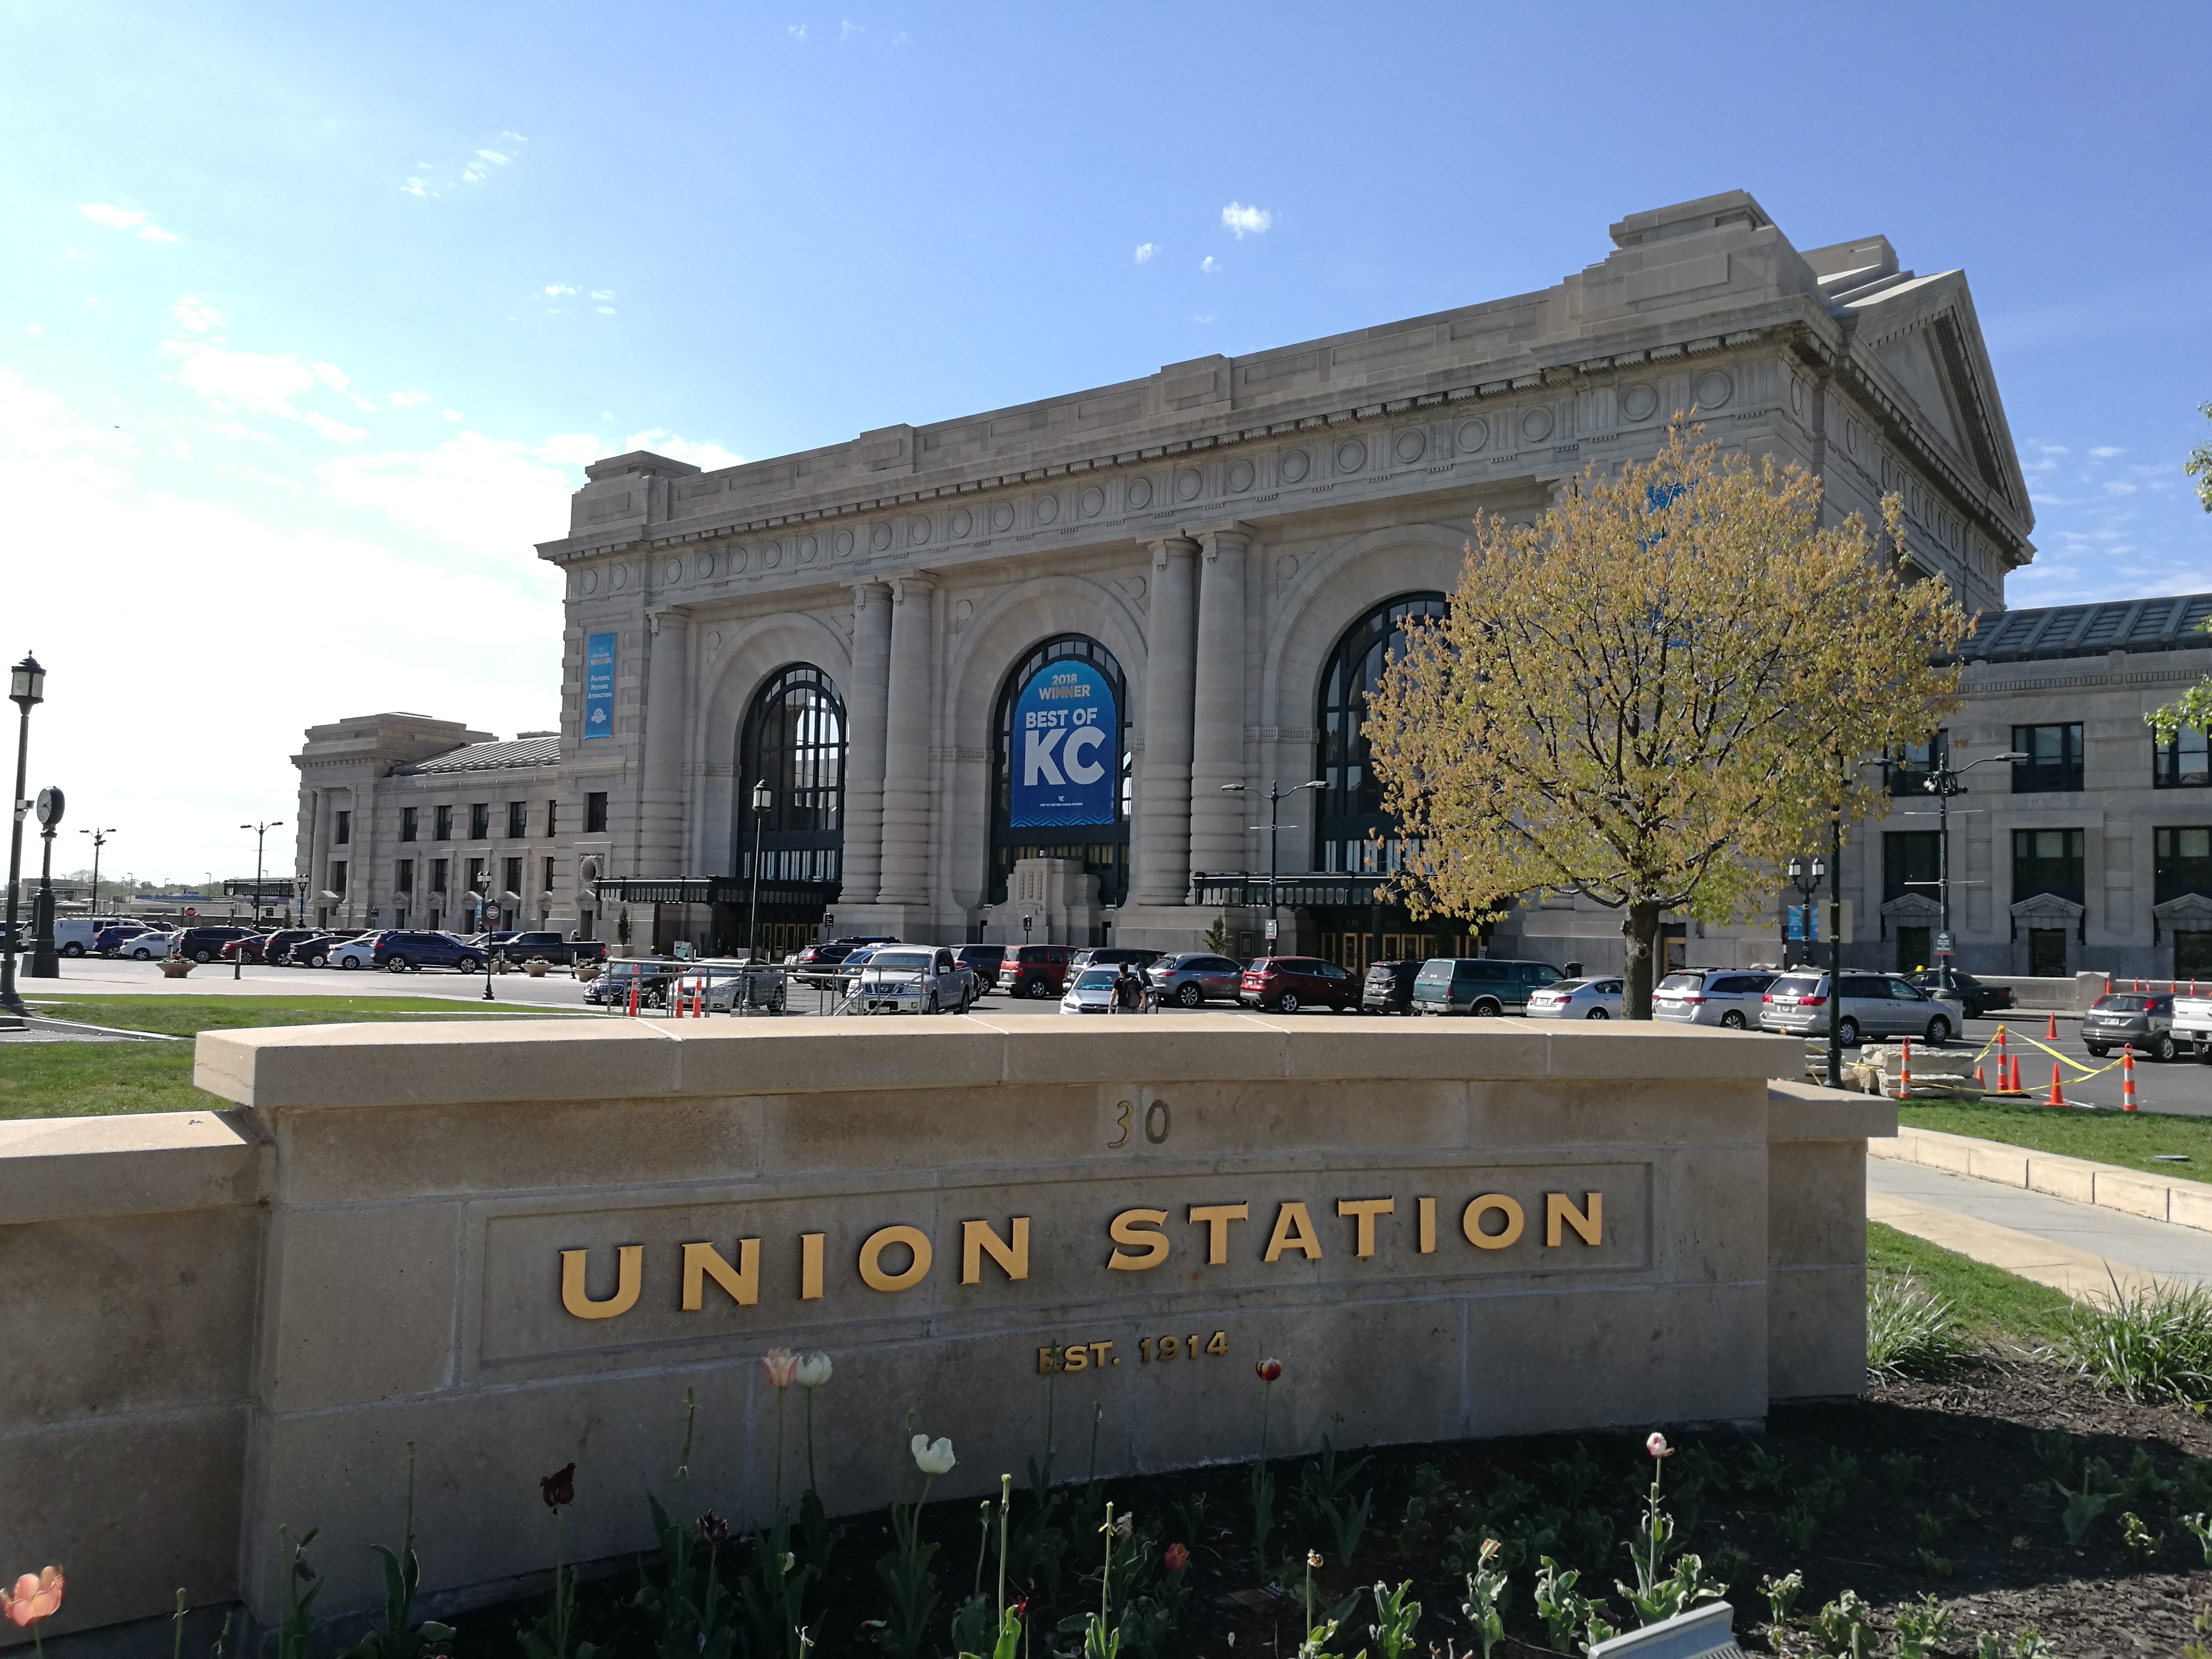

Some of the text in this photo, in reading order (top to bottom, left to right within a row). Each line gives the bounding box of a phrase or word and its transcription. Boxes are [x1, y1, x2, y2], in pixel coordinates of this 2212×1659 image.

[1039, 685, 1090, 700] WINNER
[1052, 673, 1077, 685] 2018
[1026, 707, 1098, 728] BEST OF
[1024, 726, 1106, 786] KC
[559, 1192, 1603, 1320] UNION STATION
[1037, 1330, 1228, 1374] EST. 1914
